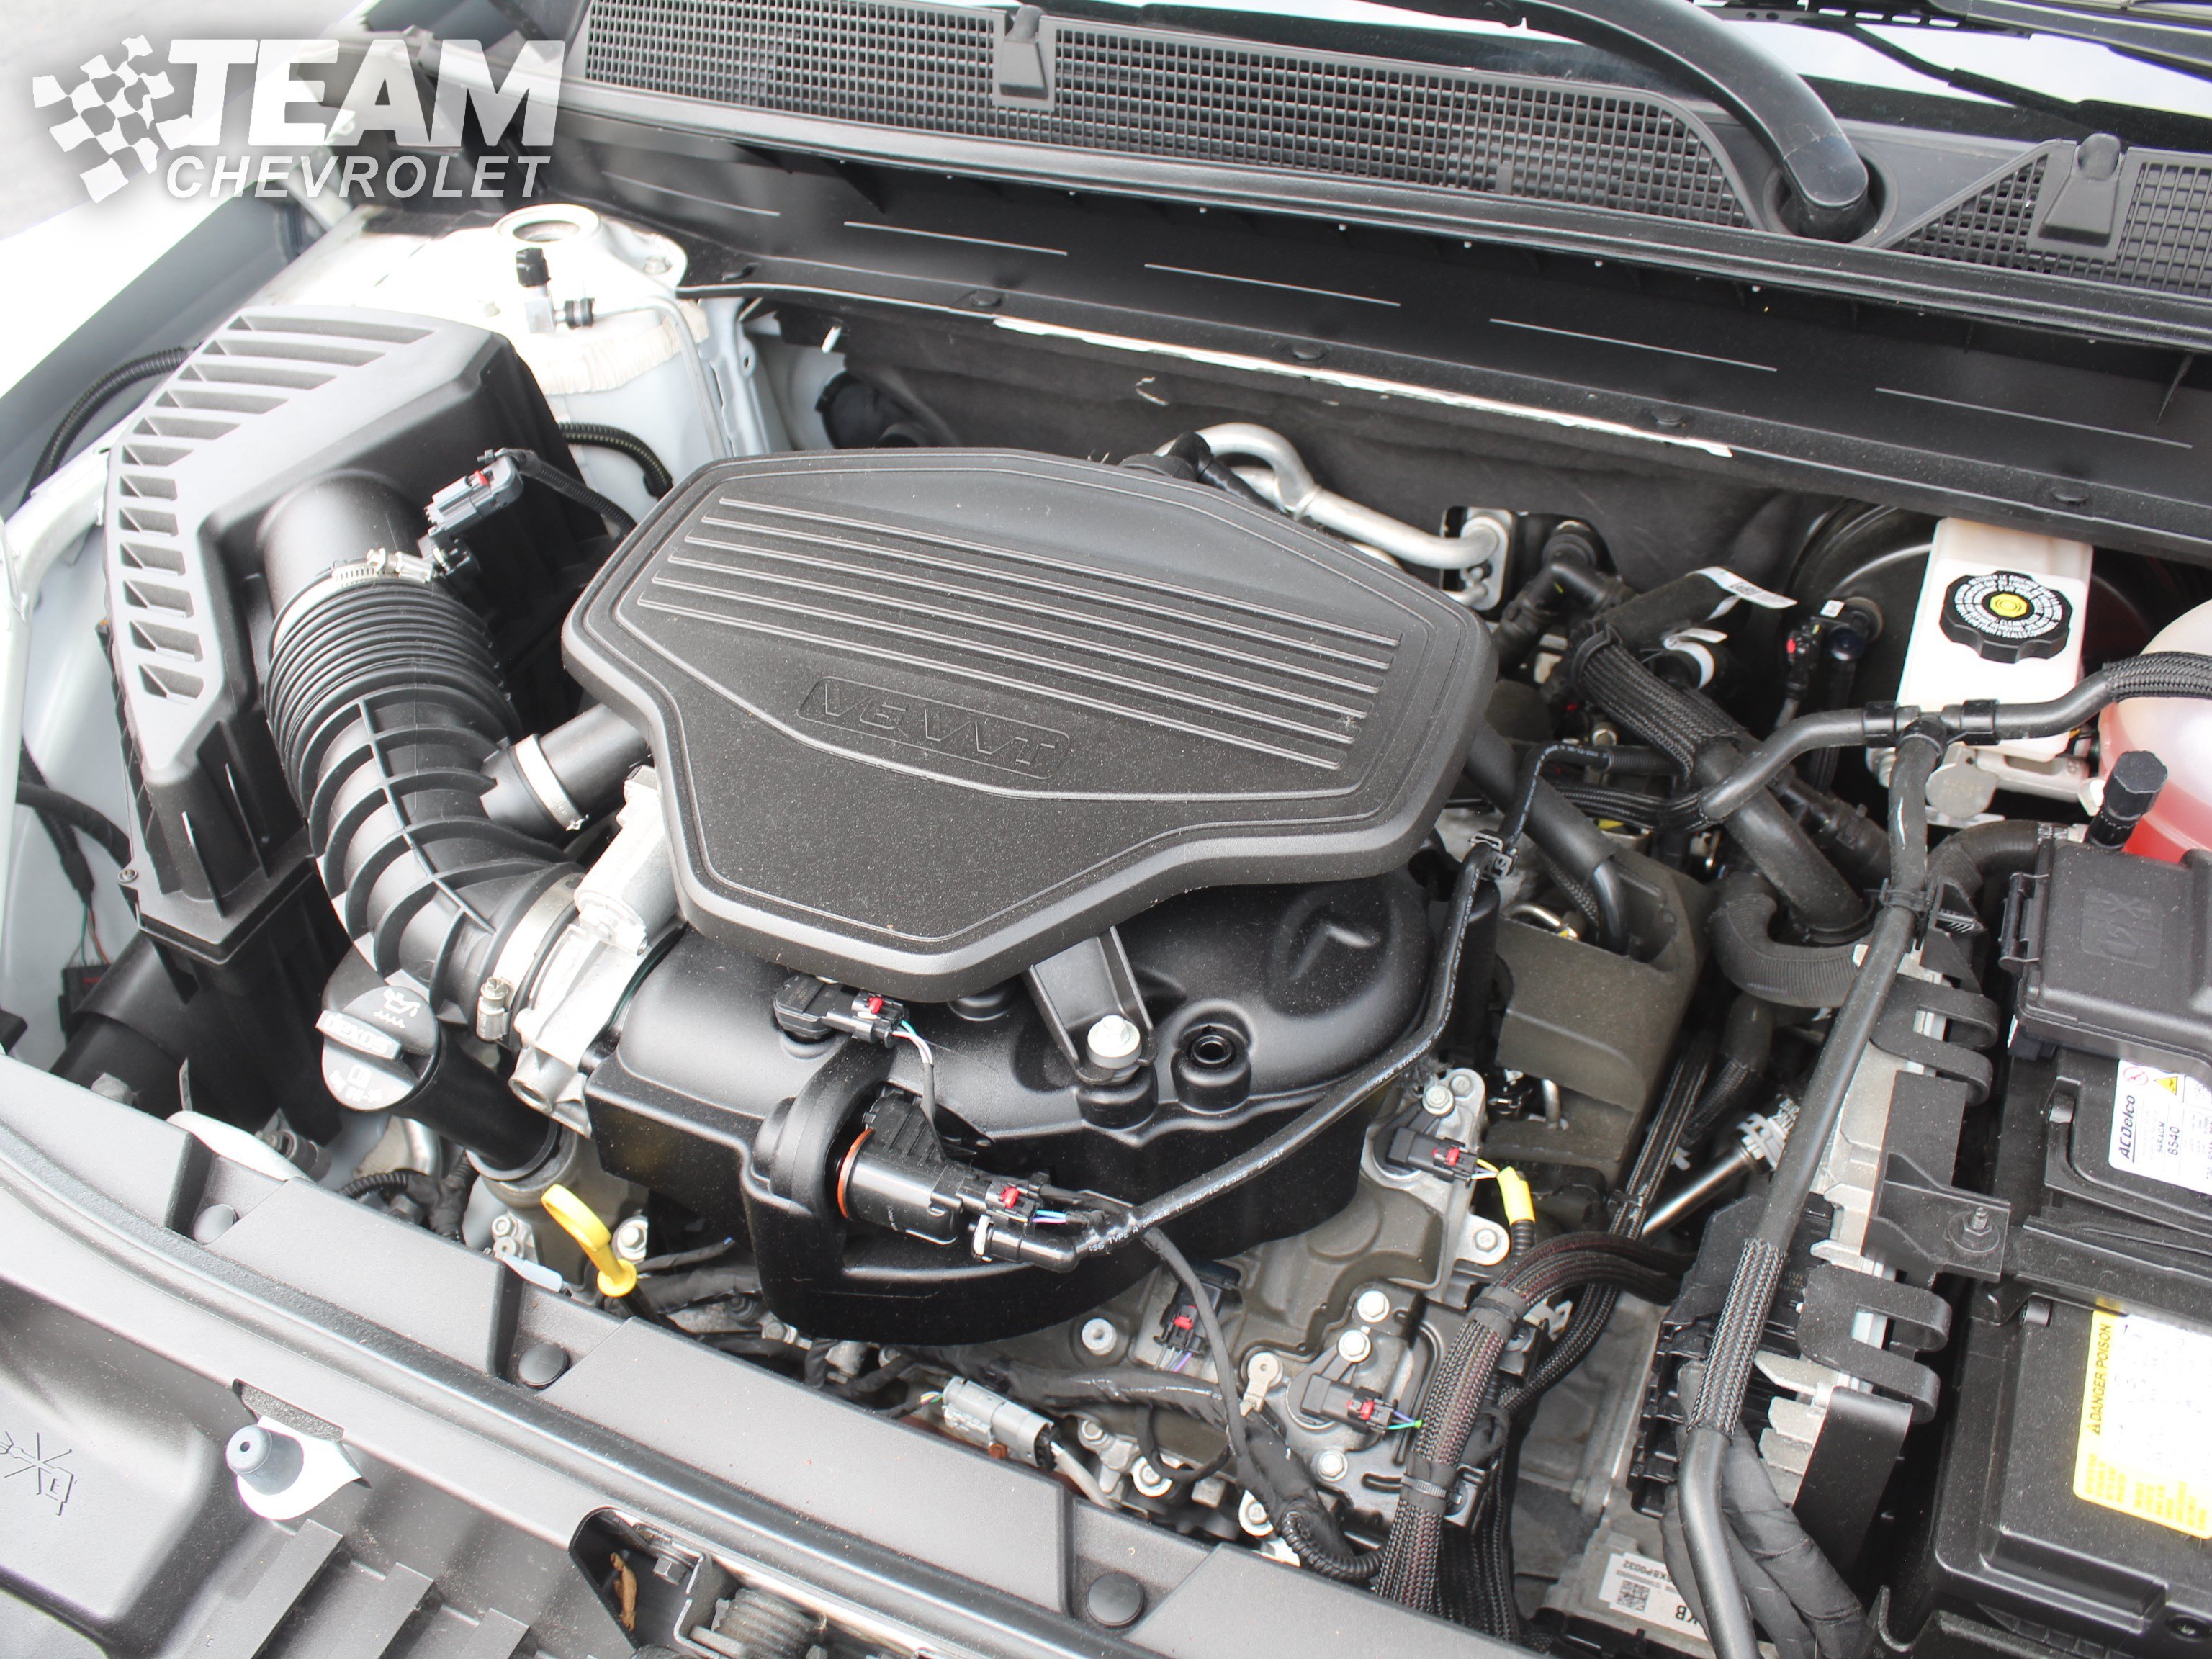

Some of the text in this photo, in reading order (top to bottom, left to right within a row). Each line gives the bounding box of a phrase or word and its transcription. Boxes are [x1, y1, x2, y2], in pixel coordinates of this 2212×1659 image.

[824, 683, 907, 730] V6
[323, 1012, 394, 1055] dexos
[2118, 1094, 2136, 1160] ACDelco
[2167, 1126, 2180, 1156] 8540
[1108, 1228, 1130, 1245] TYPE
[2089, 1323, 2112, 1422] DANGER POISON
